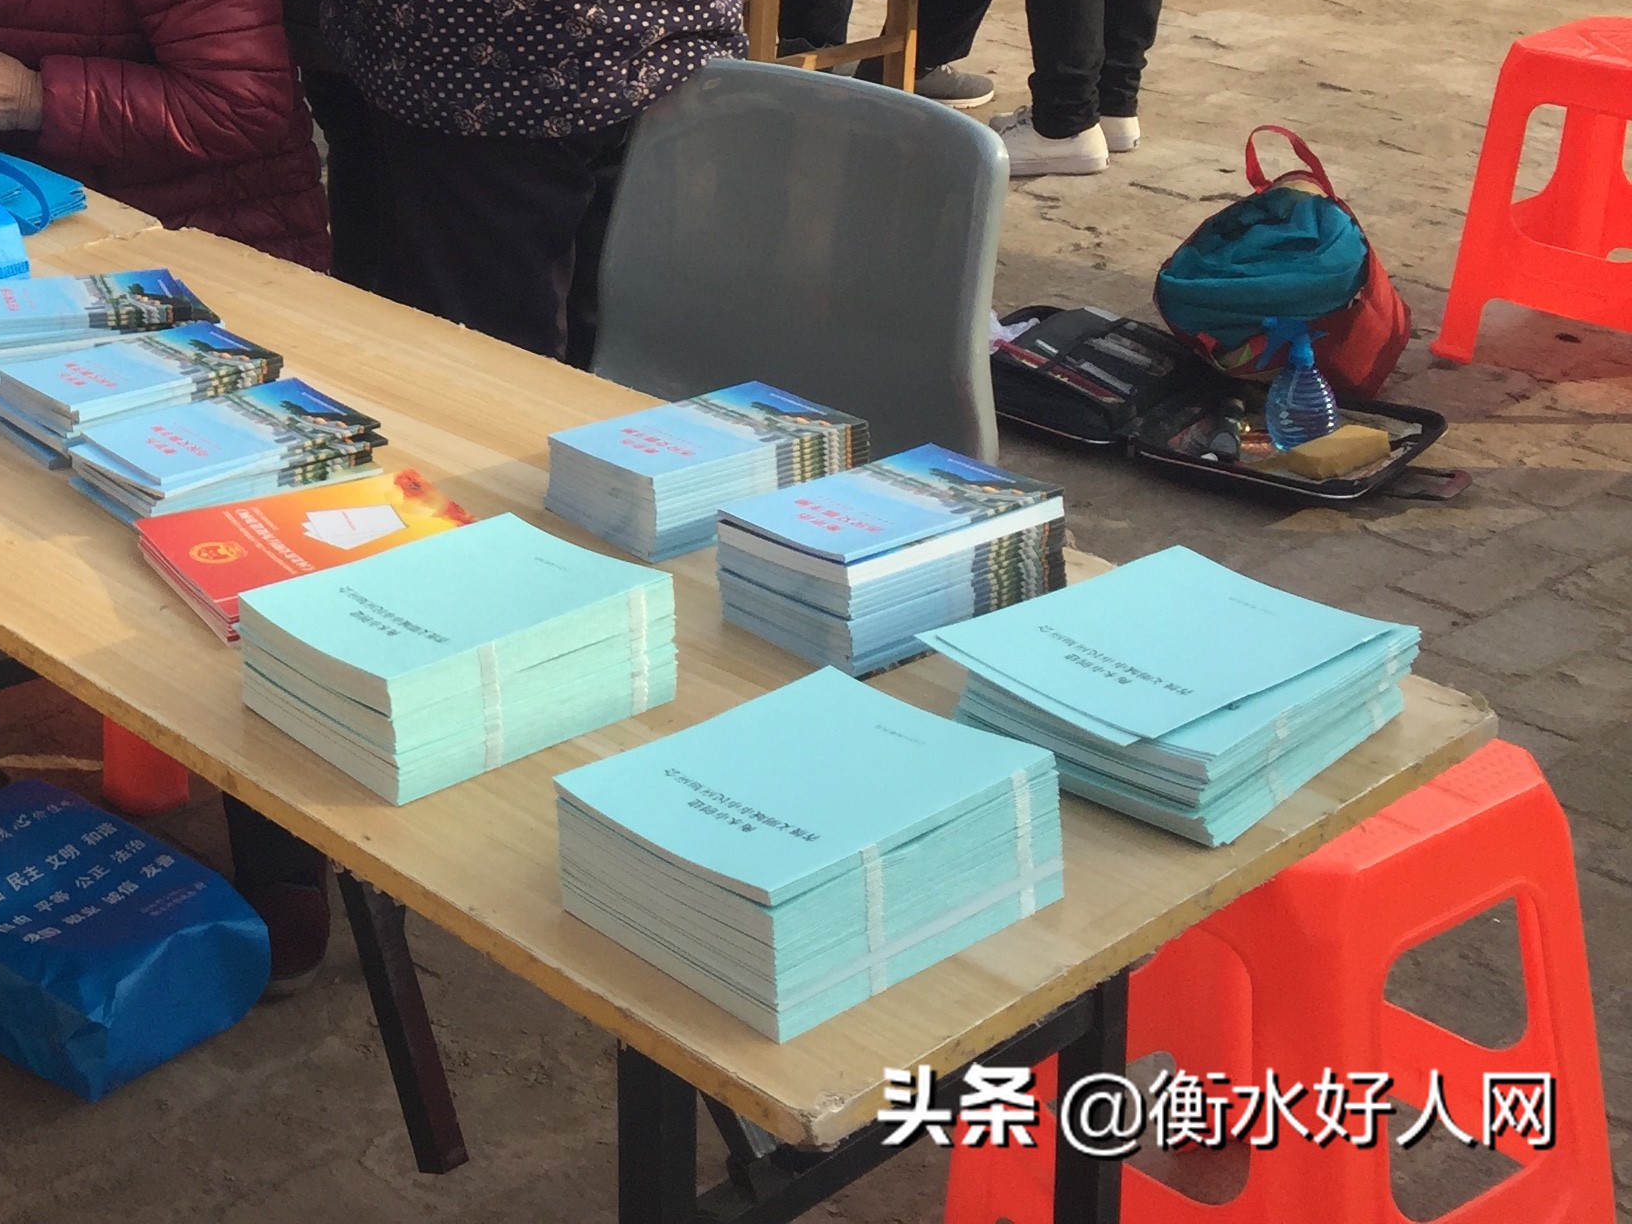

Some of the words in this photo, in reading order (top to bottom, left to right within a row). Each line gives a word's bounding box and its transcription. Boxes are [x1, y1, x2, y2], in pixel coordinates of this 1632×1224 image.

[658, 767, 823, 842] 省级文明城市市民应知应会
[683, 797, 758, 834] 衡水市创建
[6, 866, 43, 889] 民主
[44, 844, 80, 868] 文明
[81, 821, 117, 845] 和谐
[34, 890, 70, 912] 平等
[75, 866, 110, 887] 公正
[111, 839, 146, 861] 法治
[64, 904, 100, 924] 敬业
[101, 880, 139, 903] 诚信
[138, 855, 175, 876] 友善
